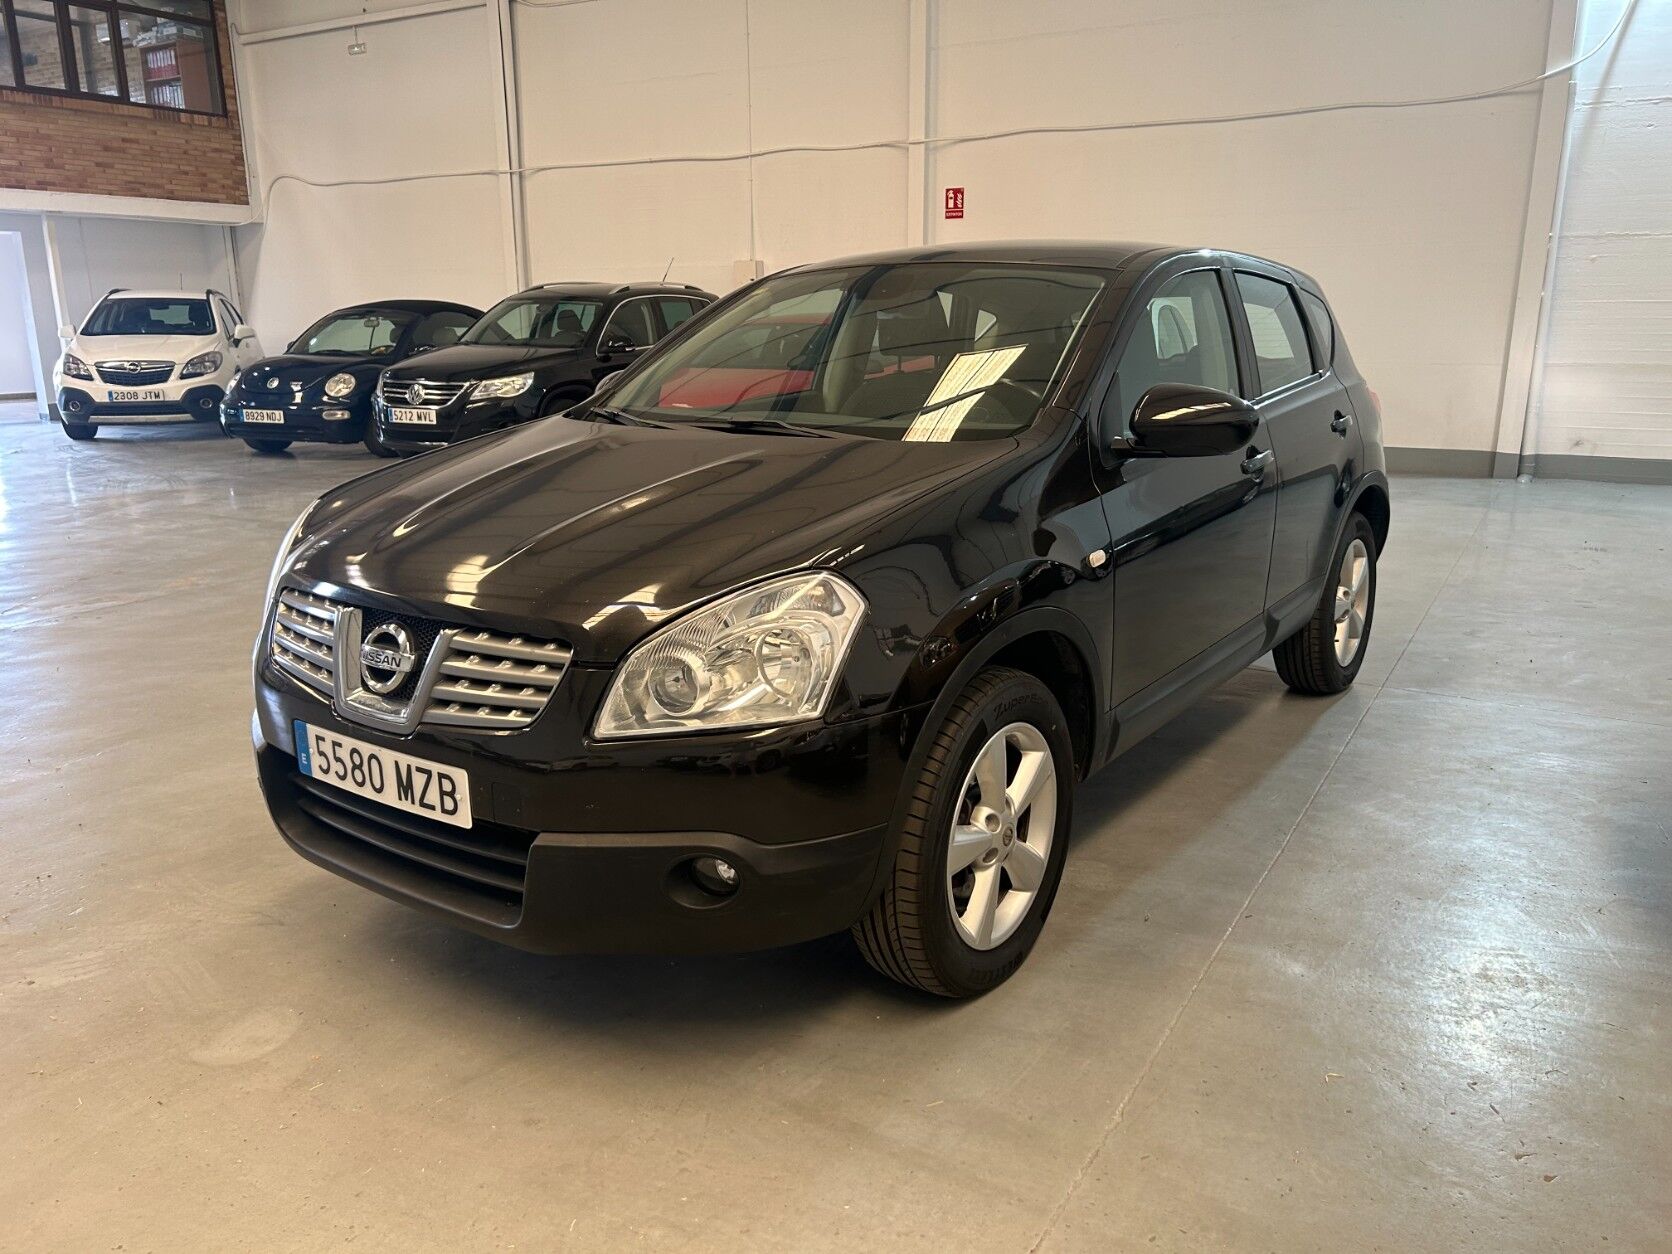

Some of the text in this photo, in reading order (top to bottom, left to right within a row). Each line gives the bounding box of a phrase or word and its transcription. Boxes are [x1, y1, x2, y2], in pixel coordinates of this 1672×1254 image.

[114, 391, 161, 400] 2308 JTM
[245, 411, 282, 422] 8929 NDJ
[393, 409, 434, 423] 5212 MVL
[315, 734, 385, 794] 5580
[394, 760, 459, 816] MZB
